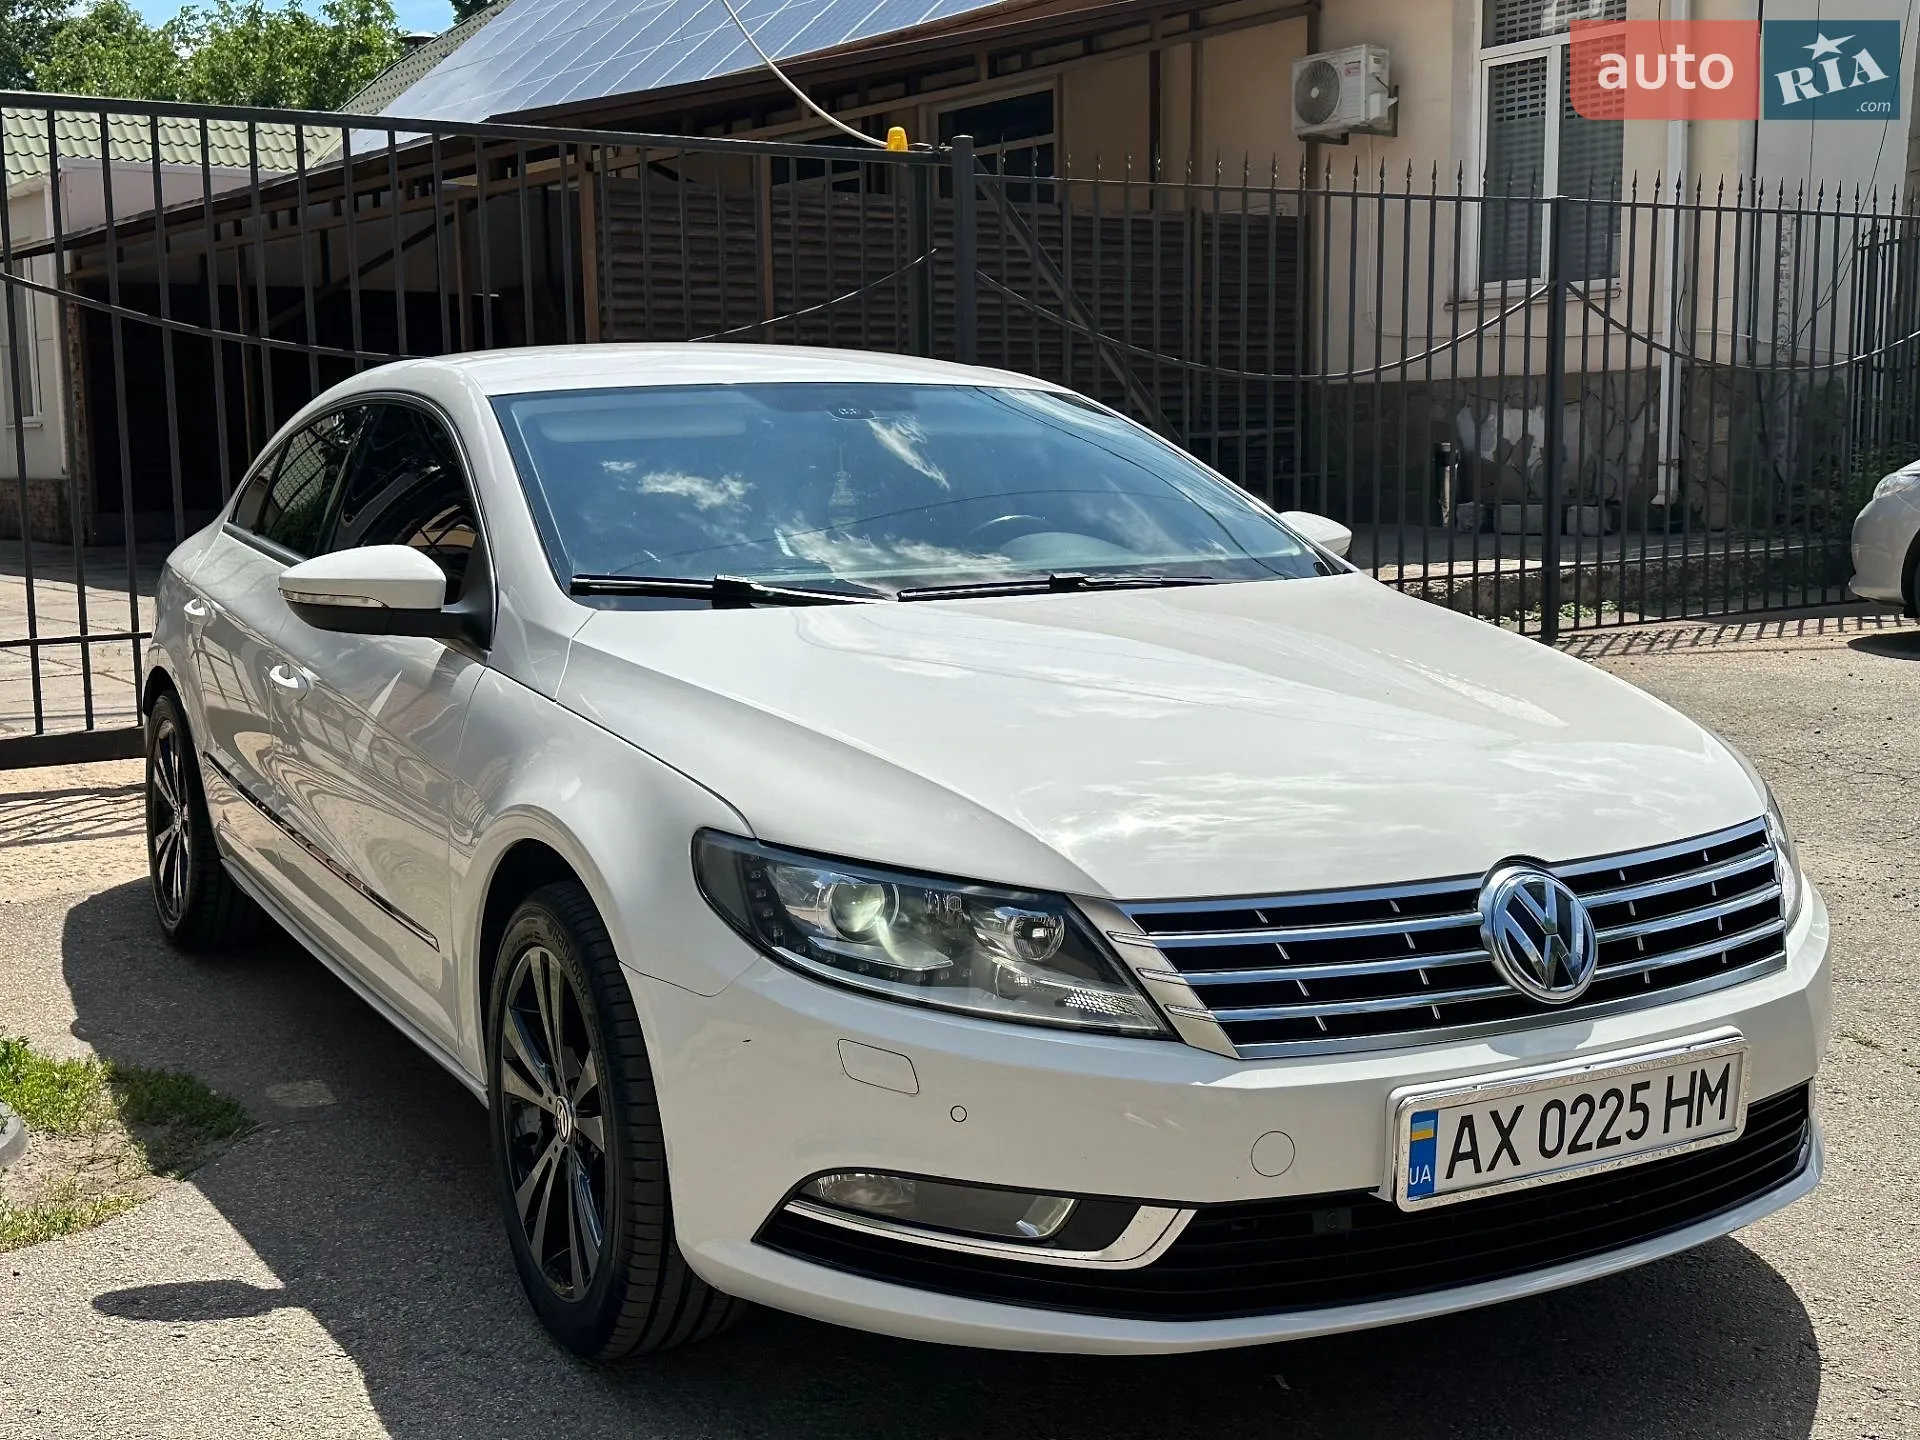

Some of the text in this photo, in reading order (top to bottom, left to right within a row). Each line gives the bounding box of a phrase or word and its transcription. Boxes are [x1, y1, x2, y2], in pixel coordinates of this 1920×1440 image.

[1445, 1062, 1731, 1180] AX 0225 HM
[1408, 1163, 1432, 1186] UA
